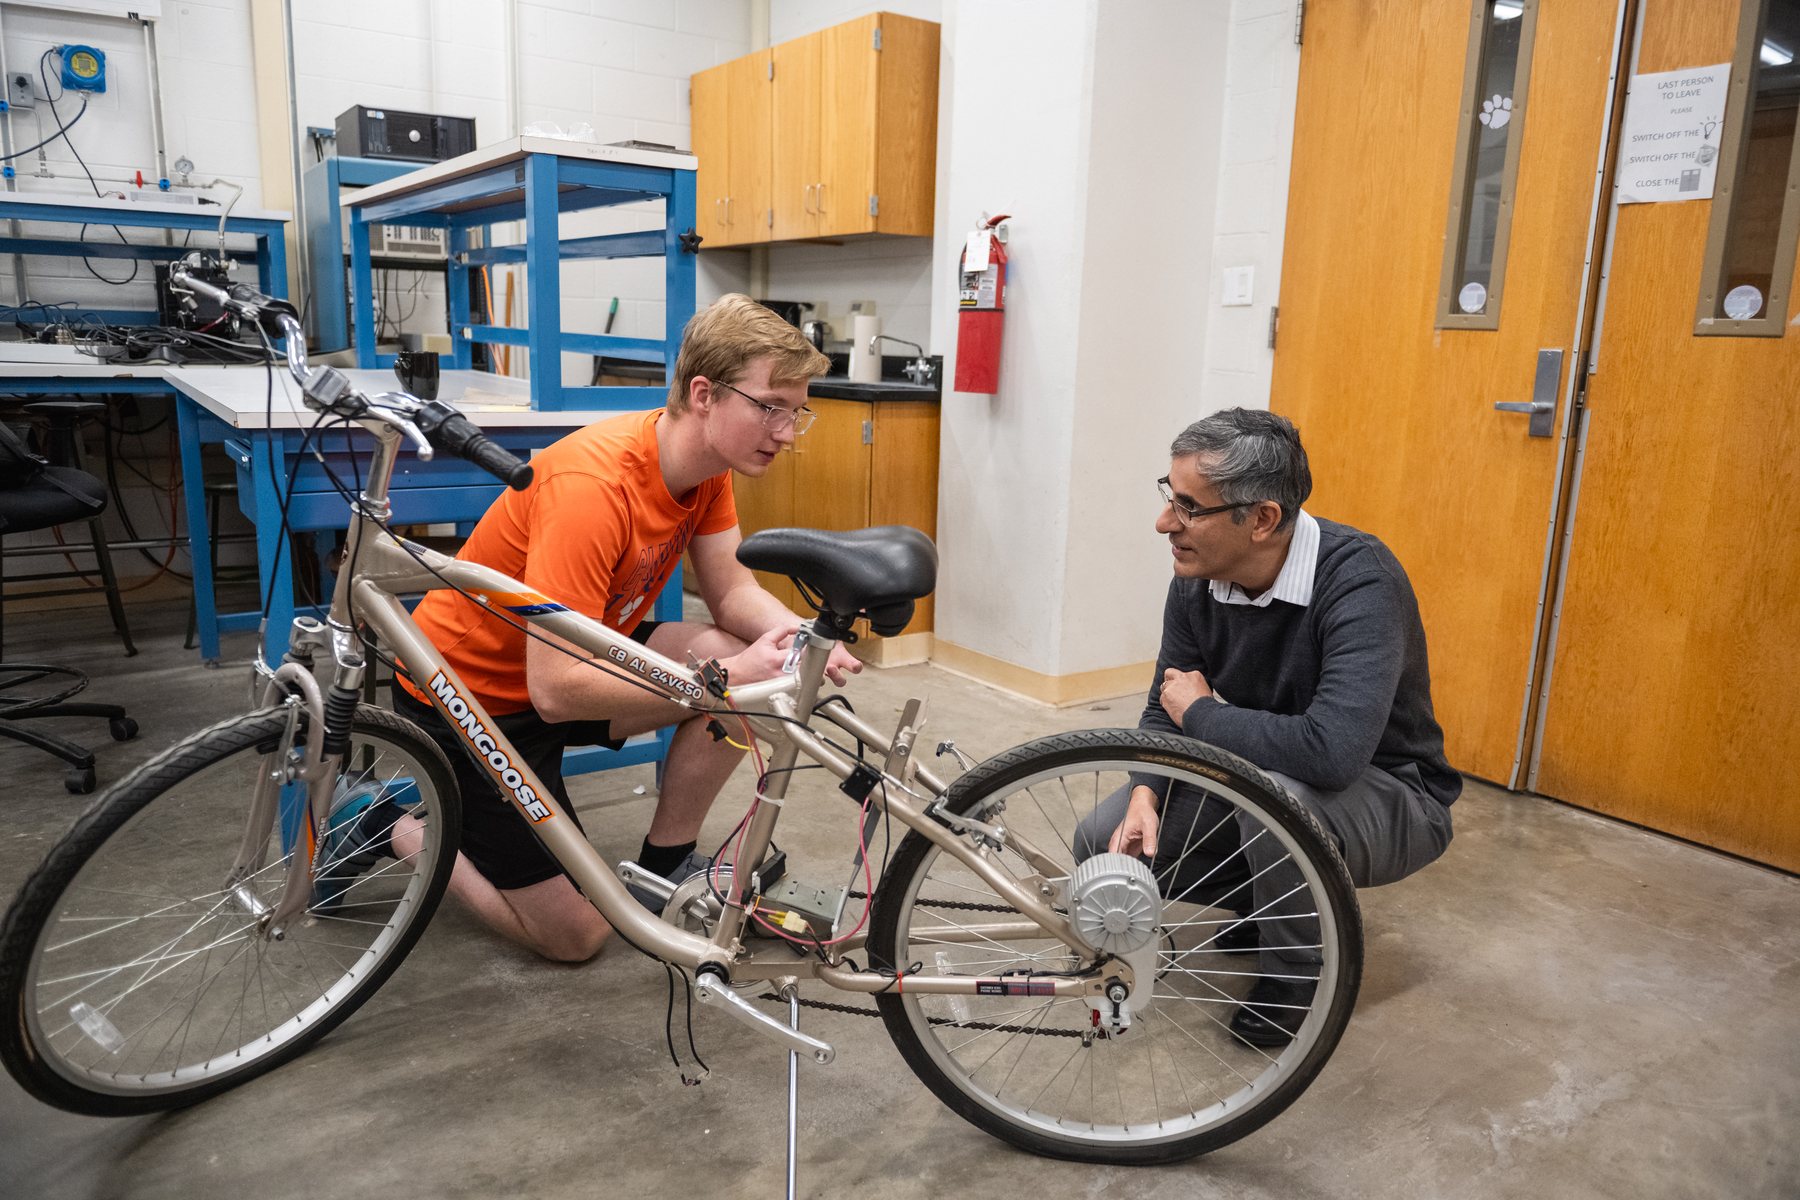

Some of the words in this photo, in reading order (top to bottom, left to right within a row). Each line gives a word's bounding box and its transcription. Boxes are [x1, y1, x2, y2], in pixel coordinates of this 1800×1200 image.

[1657, 81, 1678, 89] LAST
[1680, 76, 1714, 87] PERSON
[1662, 92, 1674, 100] TO
[1675, 89, 1701, 98] LEAVE
[1670, 106, 1693, 114] PLEASE
[1632, 131, 1663, 142] SWITCH
[1665, 131, 1681, 139] OFF
[1684, 129, 1700, 137] THE
[1630, 153, 1661, 164] SWITCH
[1663, 152, 1678, 161] OFF
[1681, 151, 1696, 159] THE
[1635, 179, 1662, 188] CLOSE
[1664, 177, 1680, 185] THE
[608, 645, 627, 662] CB
[629, 657, 646, 673] AL
[650, 667, 703, 699] 24V450
[429, 671, 551, 822] MONGOOSE
